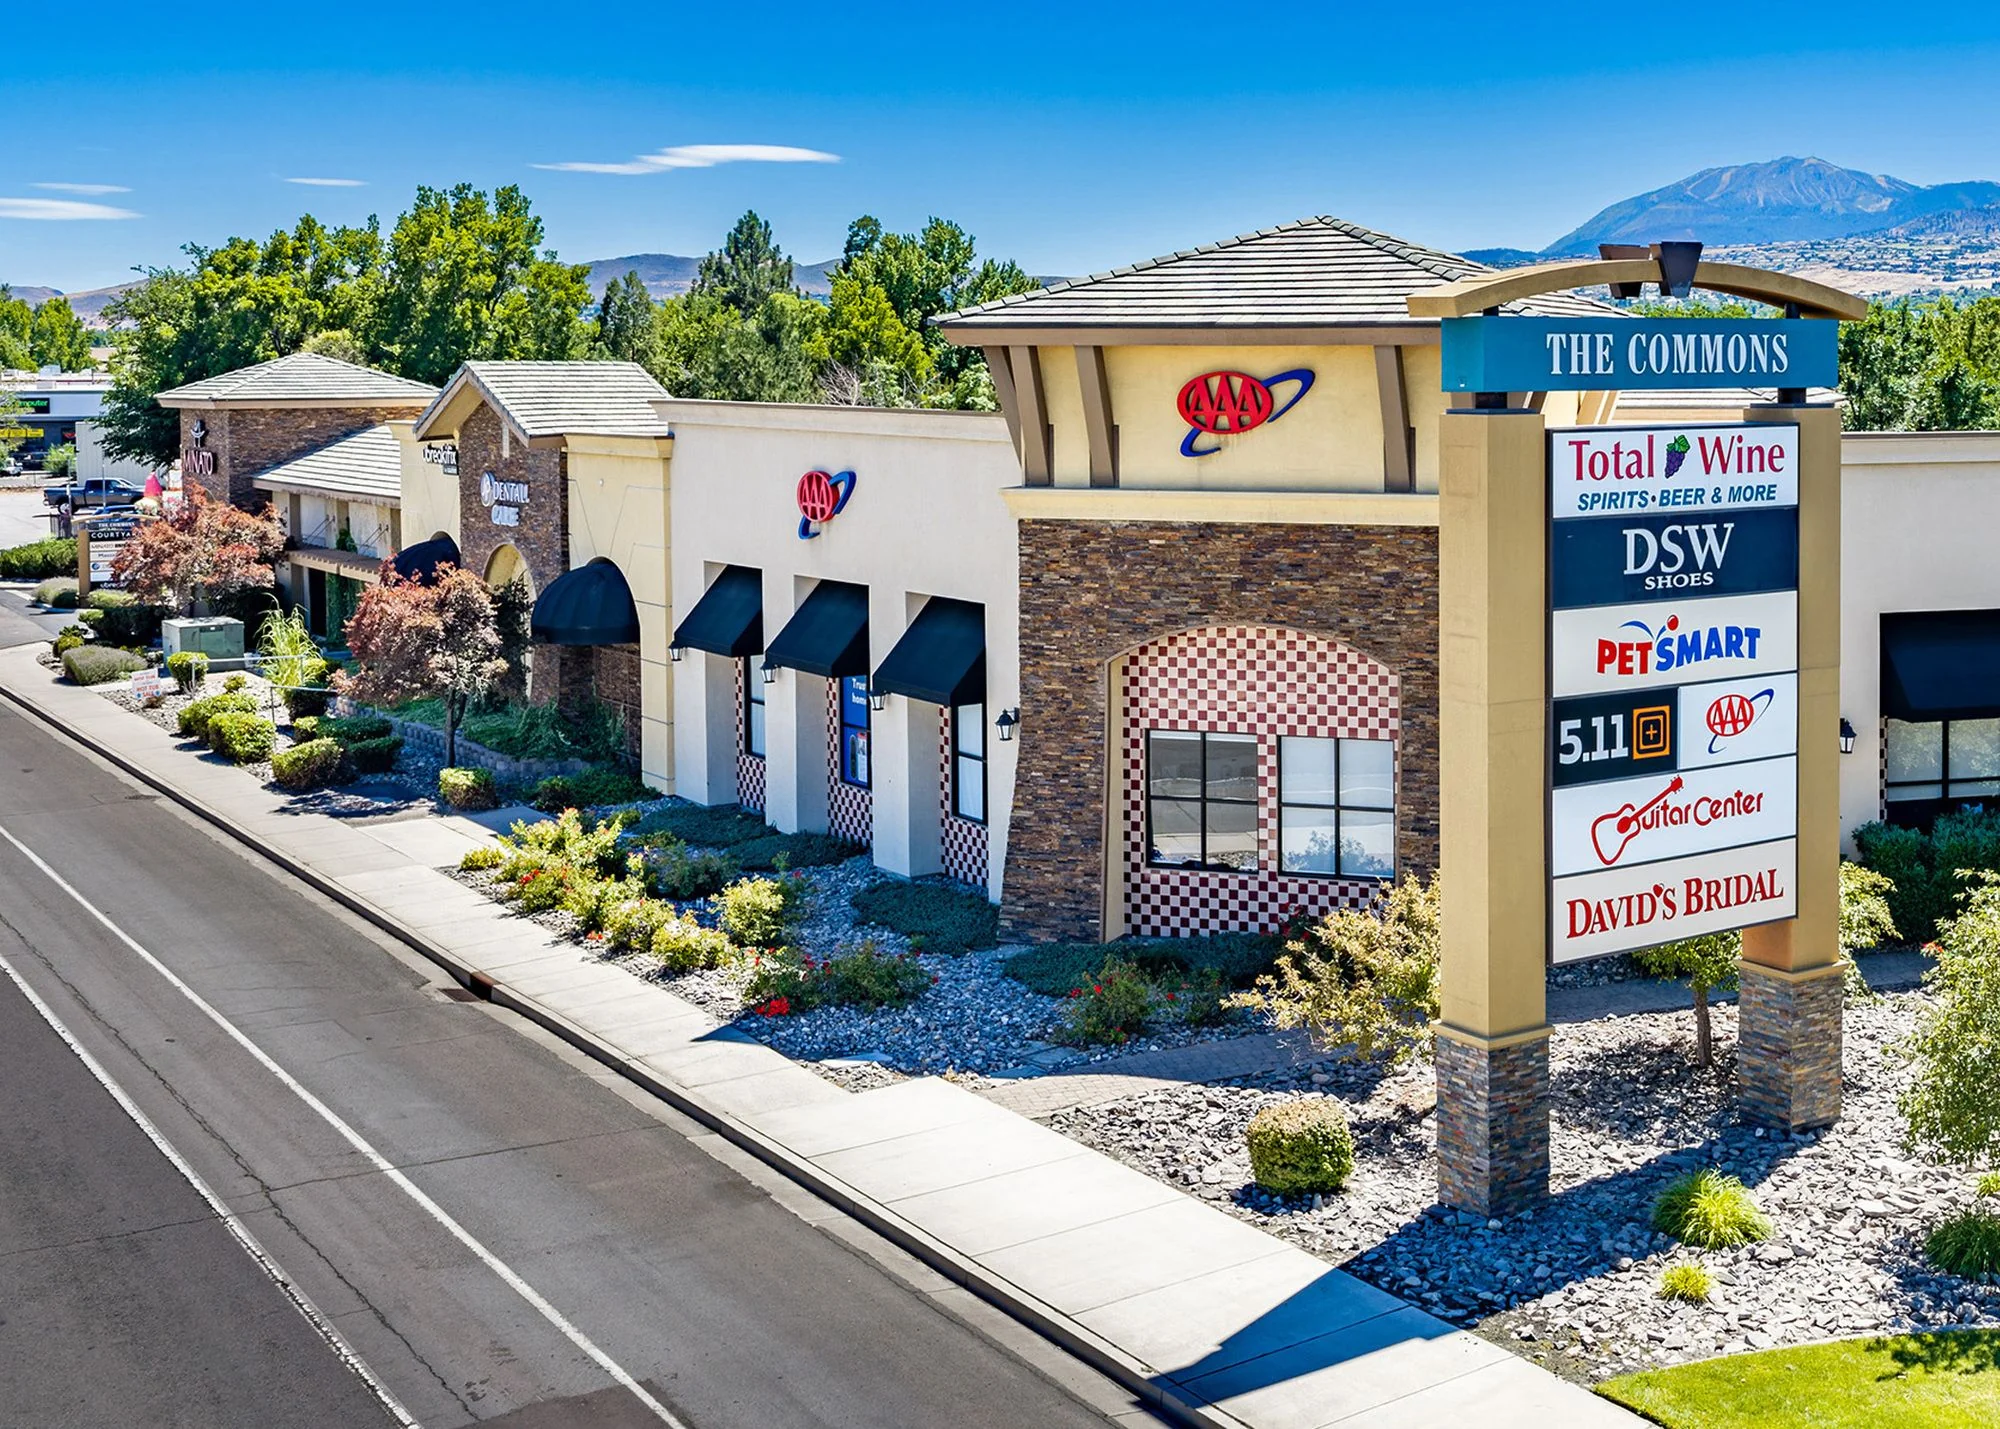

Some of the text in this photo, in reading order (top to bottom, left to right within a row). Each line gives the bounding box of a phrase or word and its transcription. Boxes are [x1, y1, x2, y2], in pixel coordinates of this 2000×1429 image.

[1546, 332, 1789, 375] THE COMMONS
[1186, 373, 1261, 432] AAA
[1568, 434, 1786, 481] Total Wine
[801, 473, 831, 520] AAA
[1577, 484, 1777, 511] SPIRITS BEER & MORE
[1623, 522, 1735, 576] DSW
[1644, 572, 1714, 591] SHOES
[1596, 626, 1761, 676] PETSMART
[1711, 695, 1752, 735] AAA
[1559, 714, 1629, 765] 5.11
[1693, 789, 1764, 827] Center
[1566, 869, 1784, 939] DAVID'S BRIDAL
